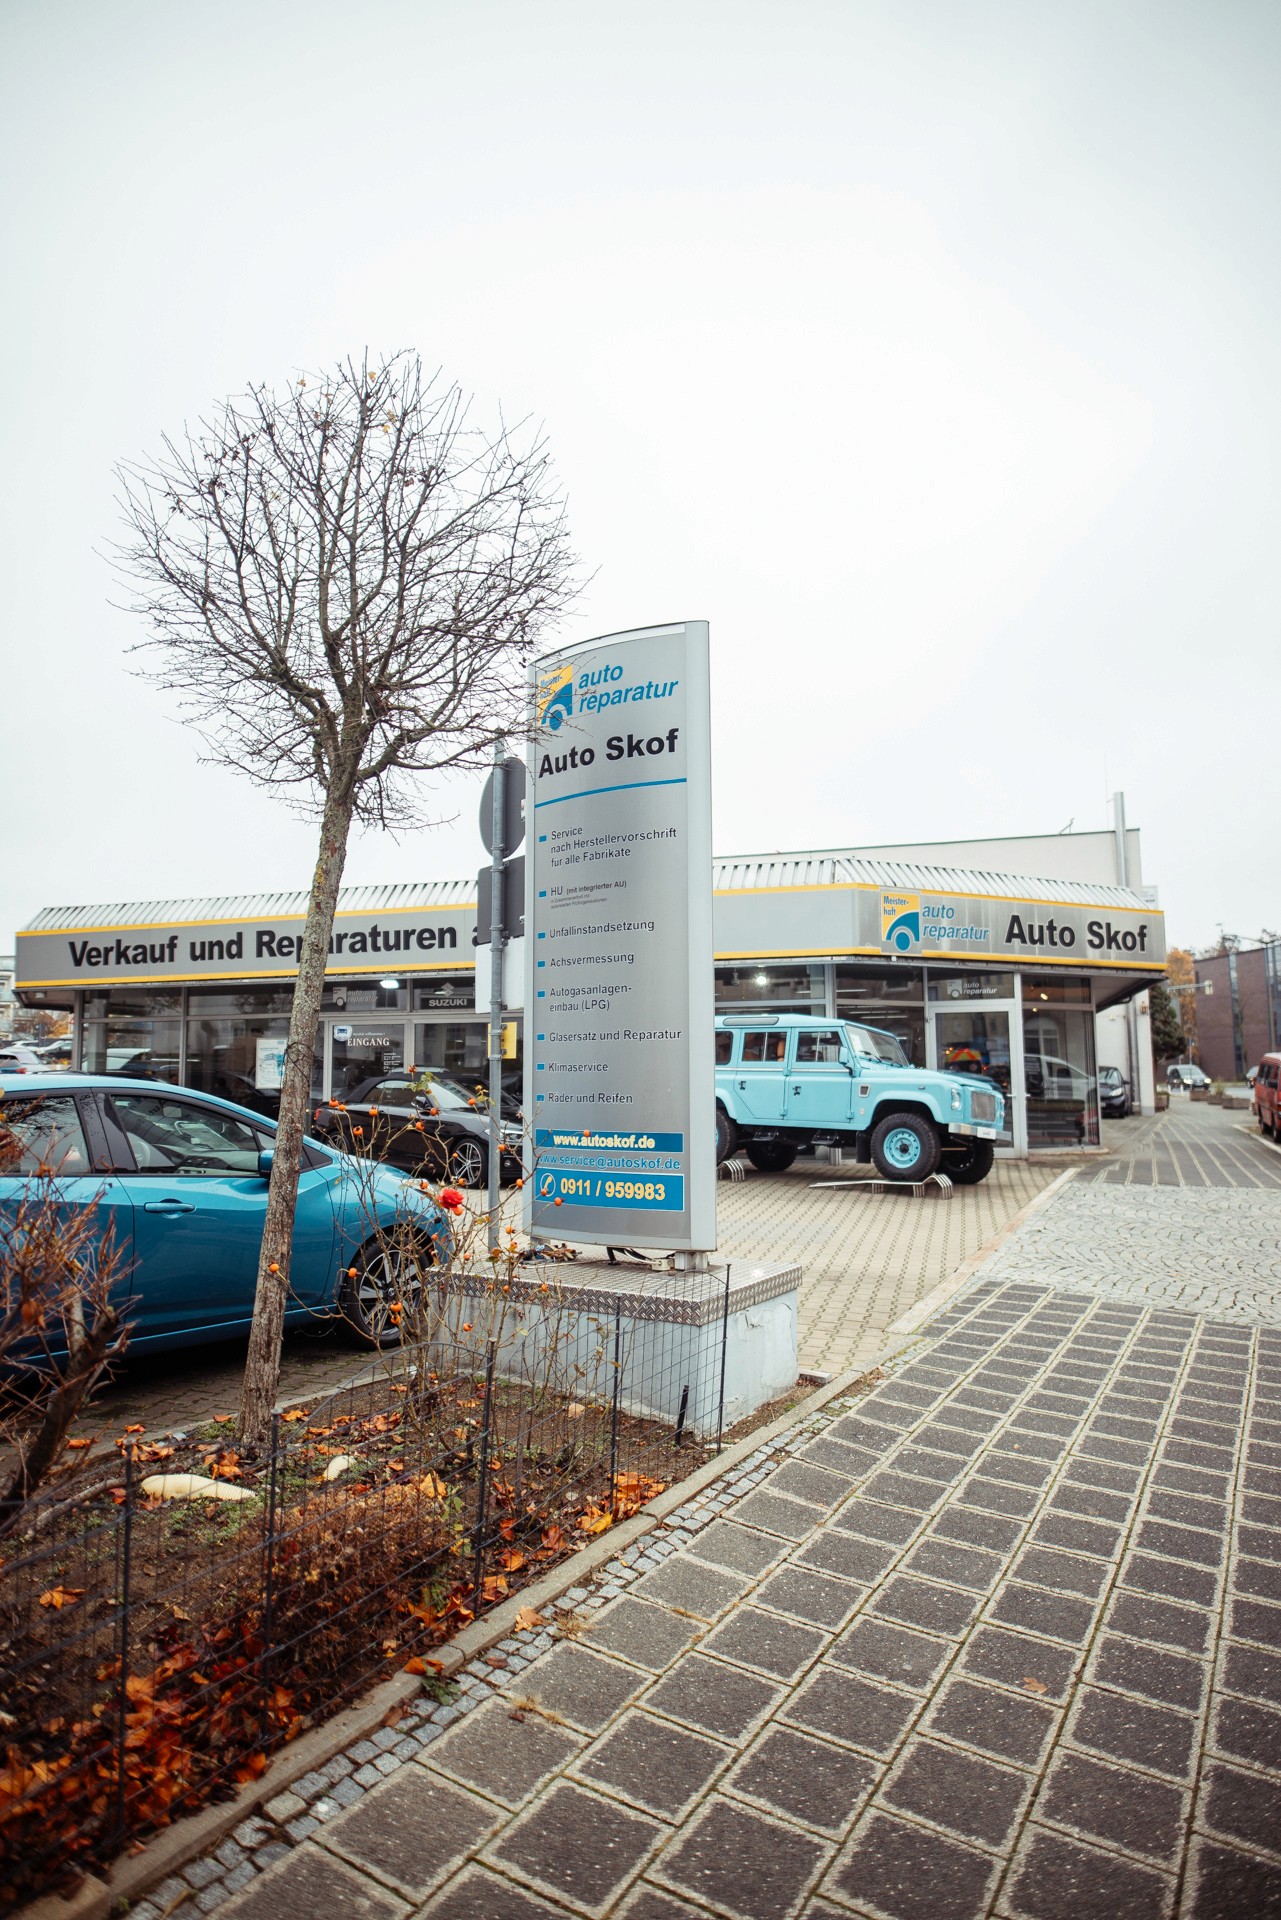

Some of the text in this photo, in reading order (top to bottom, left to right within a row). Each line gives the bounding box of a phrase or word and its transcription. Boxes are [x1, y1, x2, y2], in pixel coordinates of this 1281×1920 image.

[579, 664, 623, 689] auto
[579, 681, 678, 713] reparatur
[539, 728, 679, 778] Auto Skof
[551, 827, 583, 840] Service
[551, 828, 677, 853] nach Herstellervorschrift
[551, 848, 631, 867] für alle Fabrikate
[551, 886, 563, 896] HU
[579, 883, 612, 892] integrierter
[614, 880, 627, 888] AU)
[883, 895, 909, 906] Meister-
[922, 904, 955, 919] auto
[550, 920, 655, 939] Unfallinstandsetzung
[922, 924, 989, 942] reparatur
[1005, 914, 1147, 952] Auto Skof
[68, 935, 178, 967] Verkauf
[189, 932, 243, 961] und
[550, 953, 635, 967] Achsvermessung
[550, 983, 632, 998] Autogasanlagen-
[963, 987, 997, 995] reparatur
[428, 998, 468, 1007] SUZUKI
[550, 999, 610, 1012] einbau (LPG)
[347, 1037, 390, 1046] EINGANG
[549, 1029, 682, 1042] Glasersatz und Reparatur
[548, 1062, 609, 1072] Klimaservice
[548, 1092, 633, 1104] Räder und Reifen
[553, 1134, 656, 1149] www.autoskof.de
[560, 1177, 666, 1201] 0911 / 959983
